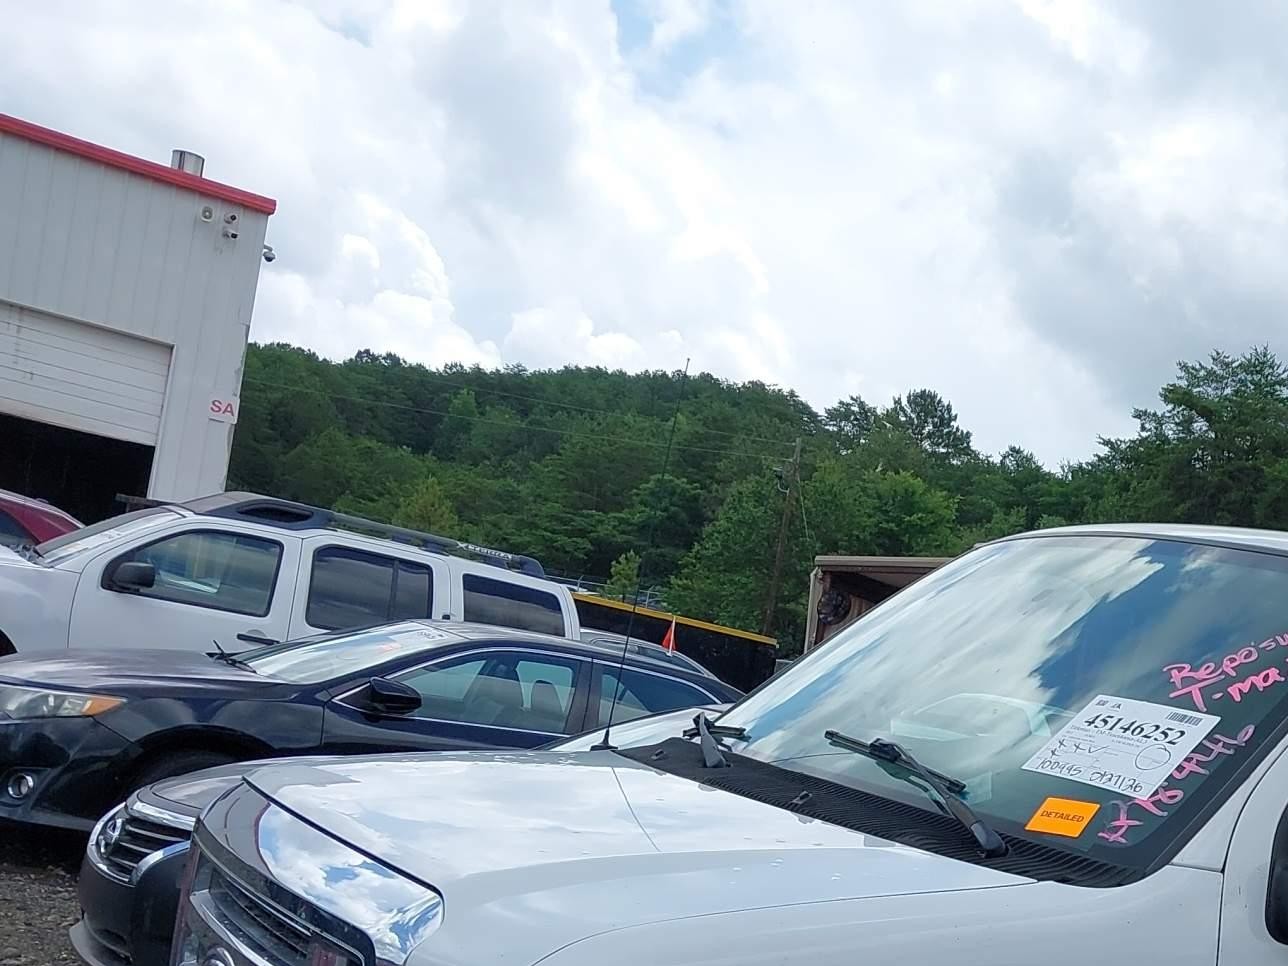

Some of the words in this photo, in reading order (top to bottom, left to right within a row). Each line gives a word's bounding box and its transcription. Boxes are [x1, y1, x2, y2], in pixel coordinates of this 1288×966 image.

[210, 400, 235, 416] SA
[1083, 713, 1187, 746] 45146252
[1040, 810, 1085, 823] DETAILED
